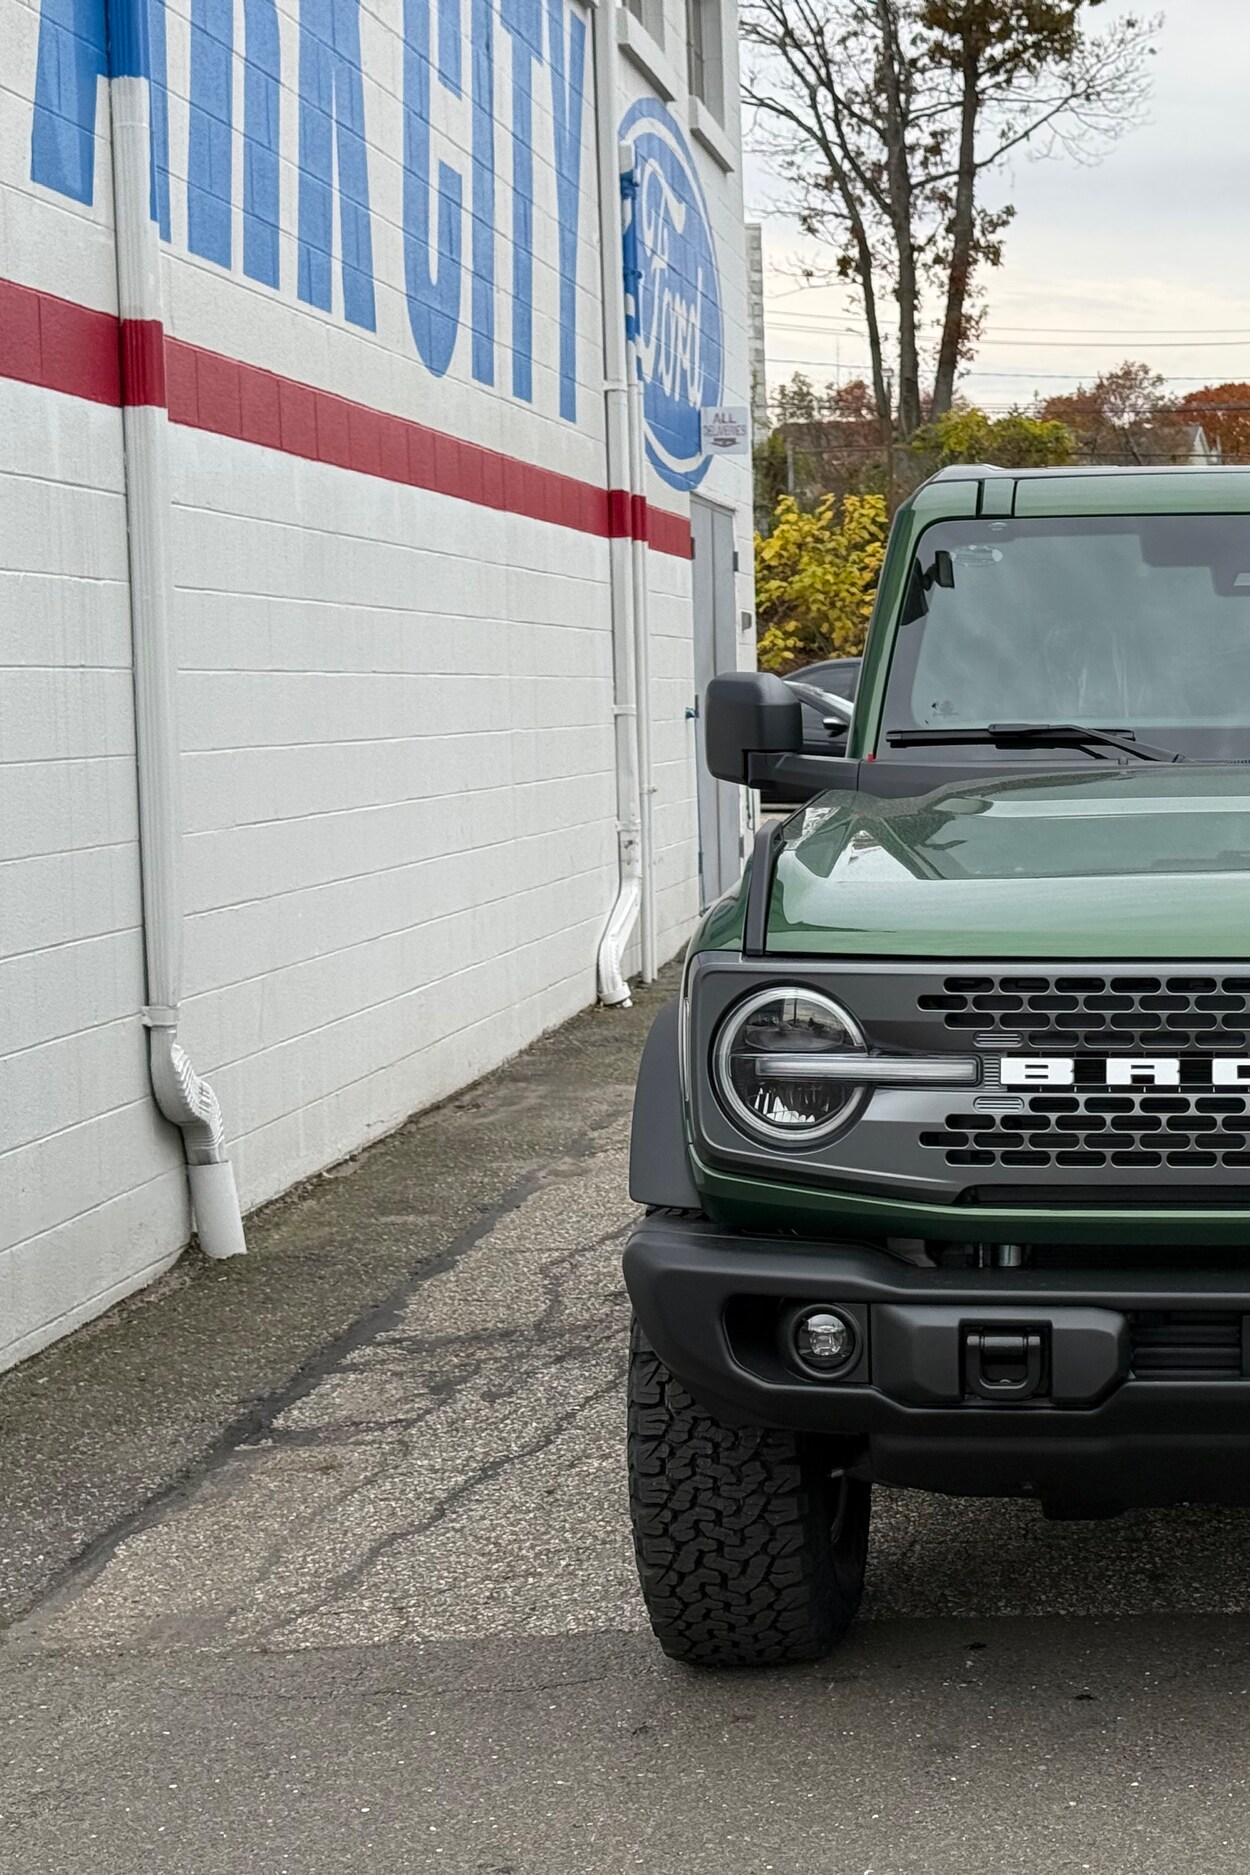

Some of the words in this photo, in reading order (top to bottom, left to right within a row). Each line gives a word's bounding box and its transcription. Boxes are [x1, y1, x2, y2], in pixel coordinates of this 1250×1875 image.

[402, 0, 586, 424] CITY
[637, 157, 705, 411] Ford
[712, 412, 737, 424] ALL
